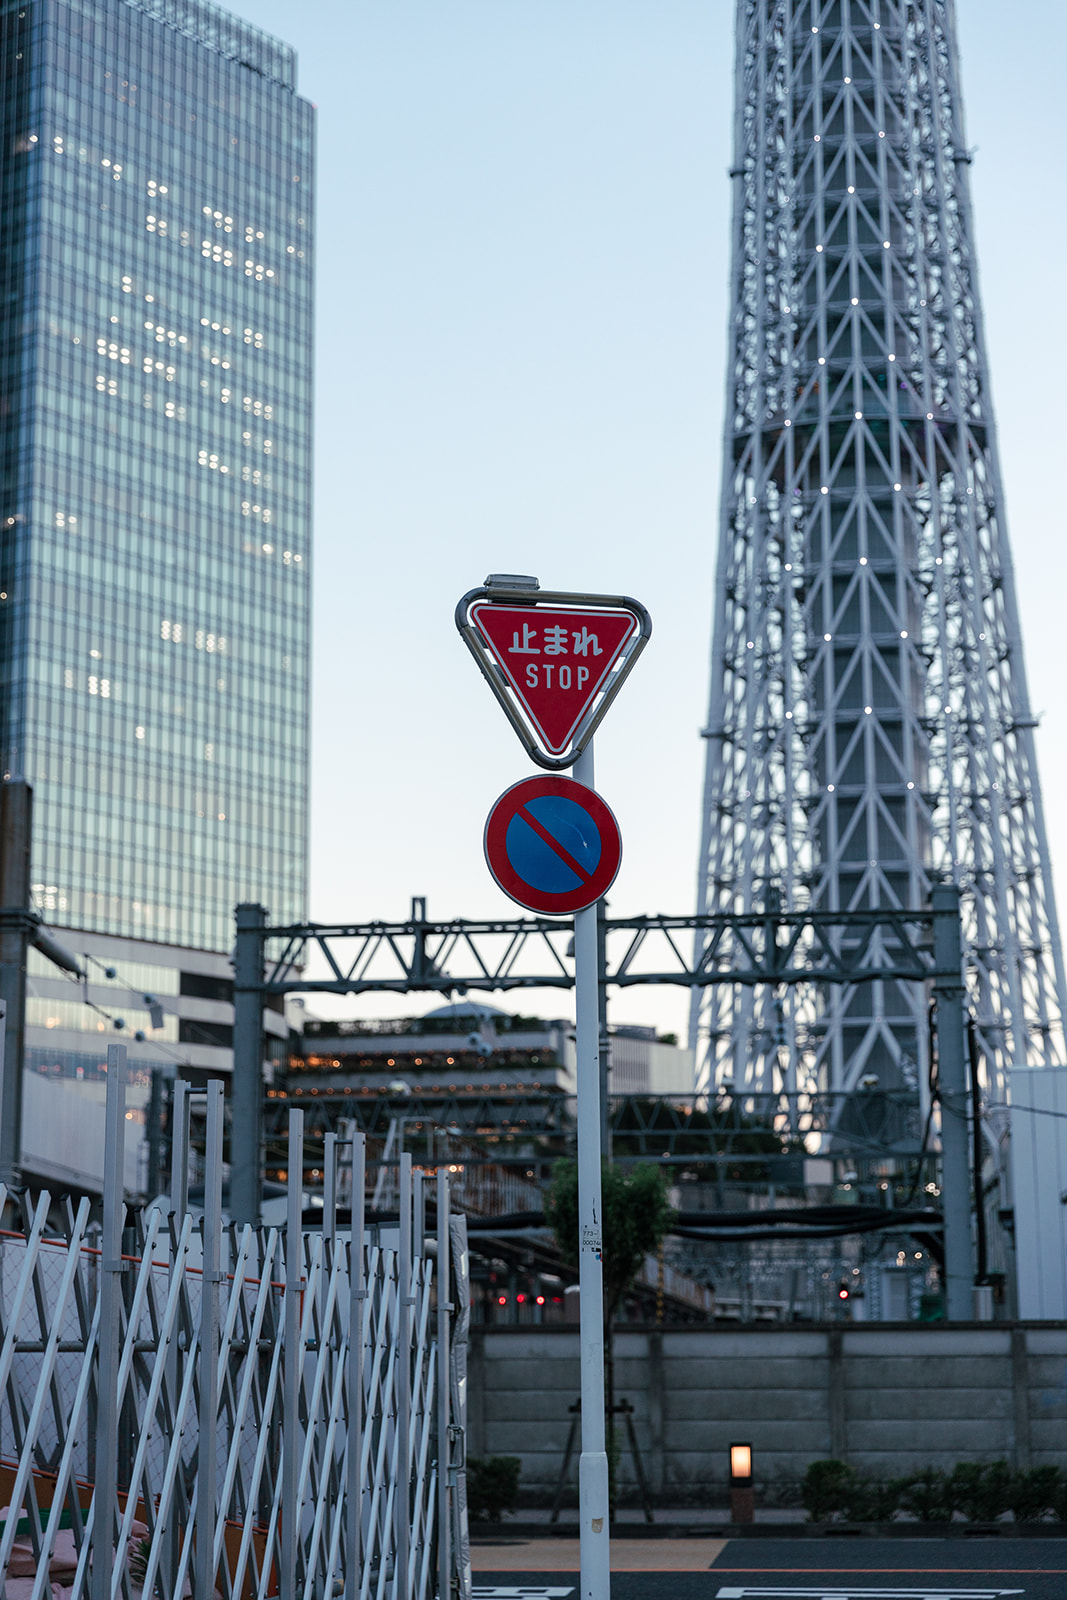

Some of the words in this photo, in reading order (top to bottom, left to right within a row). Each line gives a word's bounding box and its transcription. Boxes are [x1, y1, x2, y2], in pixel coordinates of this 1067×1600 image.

[508, 623, 603, 657] 止まれ
[525, 663, 590, 690] STOP
